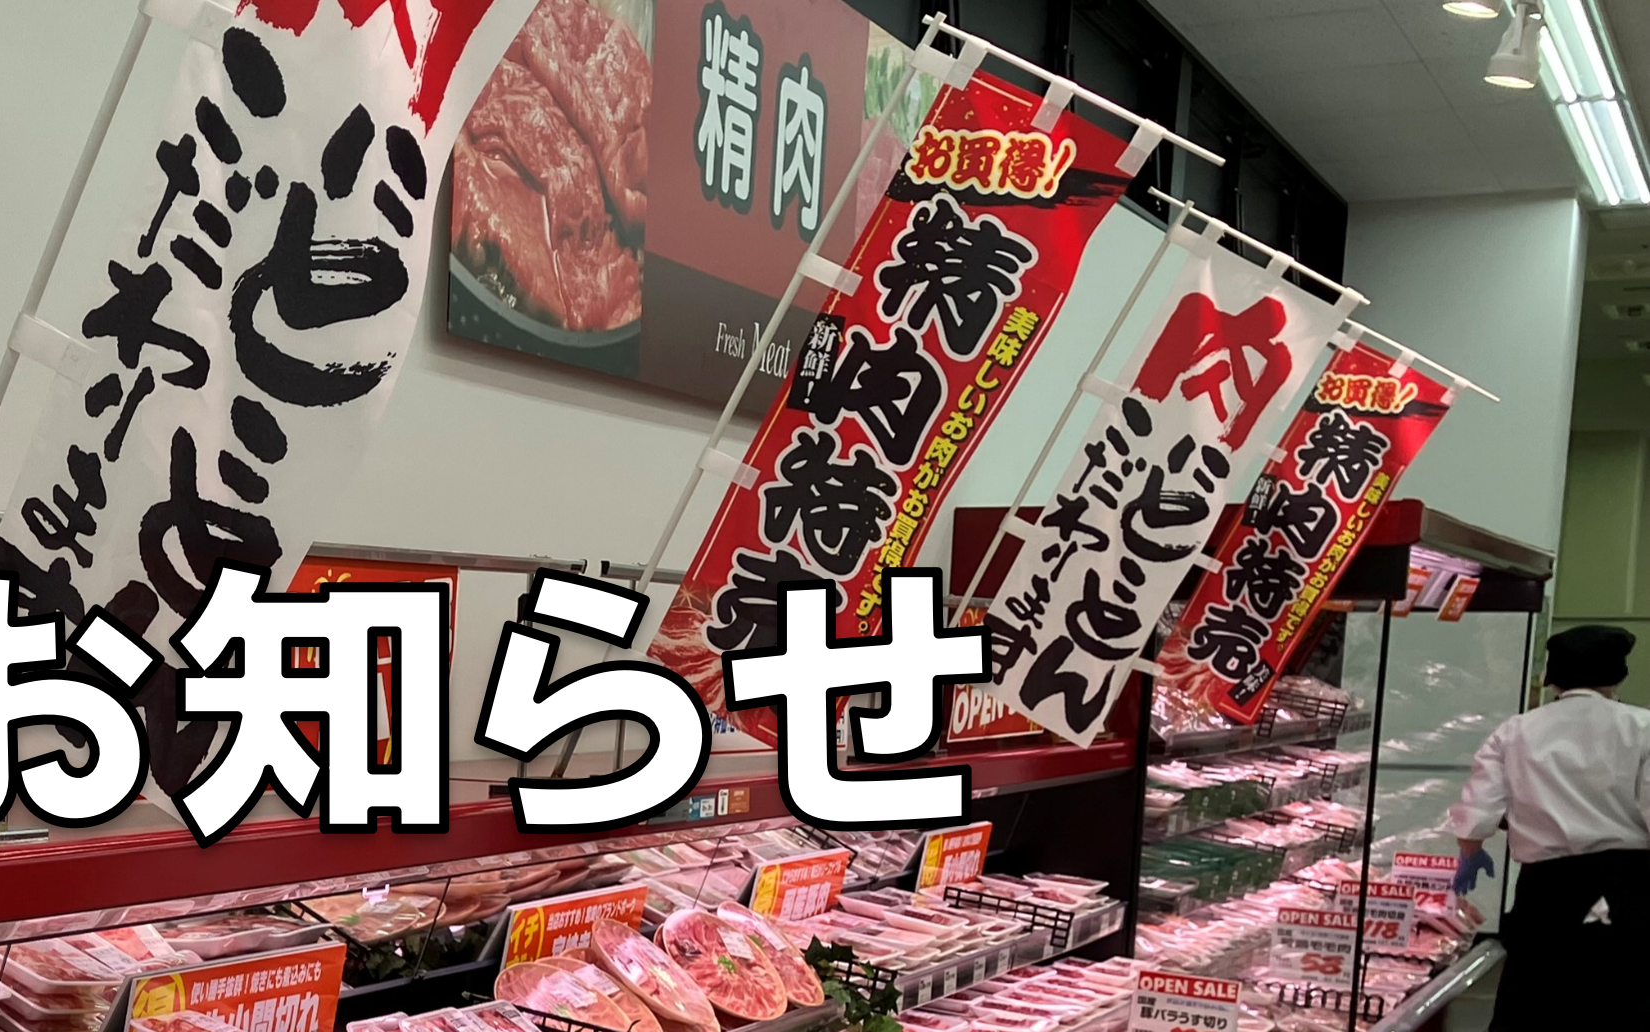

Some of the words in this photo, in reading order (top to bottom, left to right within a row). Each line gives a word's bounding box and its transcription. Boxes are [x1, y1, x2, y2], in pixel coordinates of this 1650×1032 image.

[695, 13, 826, 232] 精肉
[715, 322, 746, 360] Fresh
[799, 319, 839, 404] 新鮮!
[1131, 292, 1293, 453] 肉
[1188, 410, 1389, 683] 精肉特売
[1341, 882, 1378, 896] OPN
[1381, 884, 1414, 899] SALE
[1279, 910, 1320, 928] OPEN
[1301, 953, 1345, 976] 58
[1139, 976, 1189, 994] OPEN
[1193, 981, 1237, 999] SALE
[1140, 1006, 1228, 1030] 豚バラうす切り
